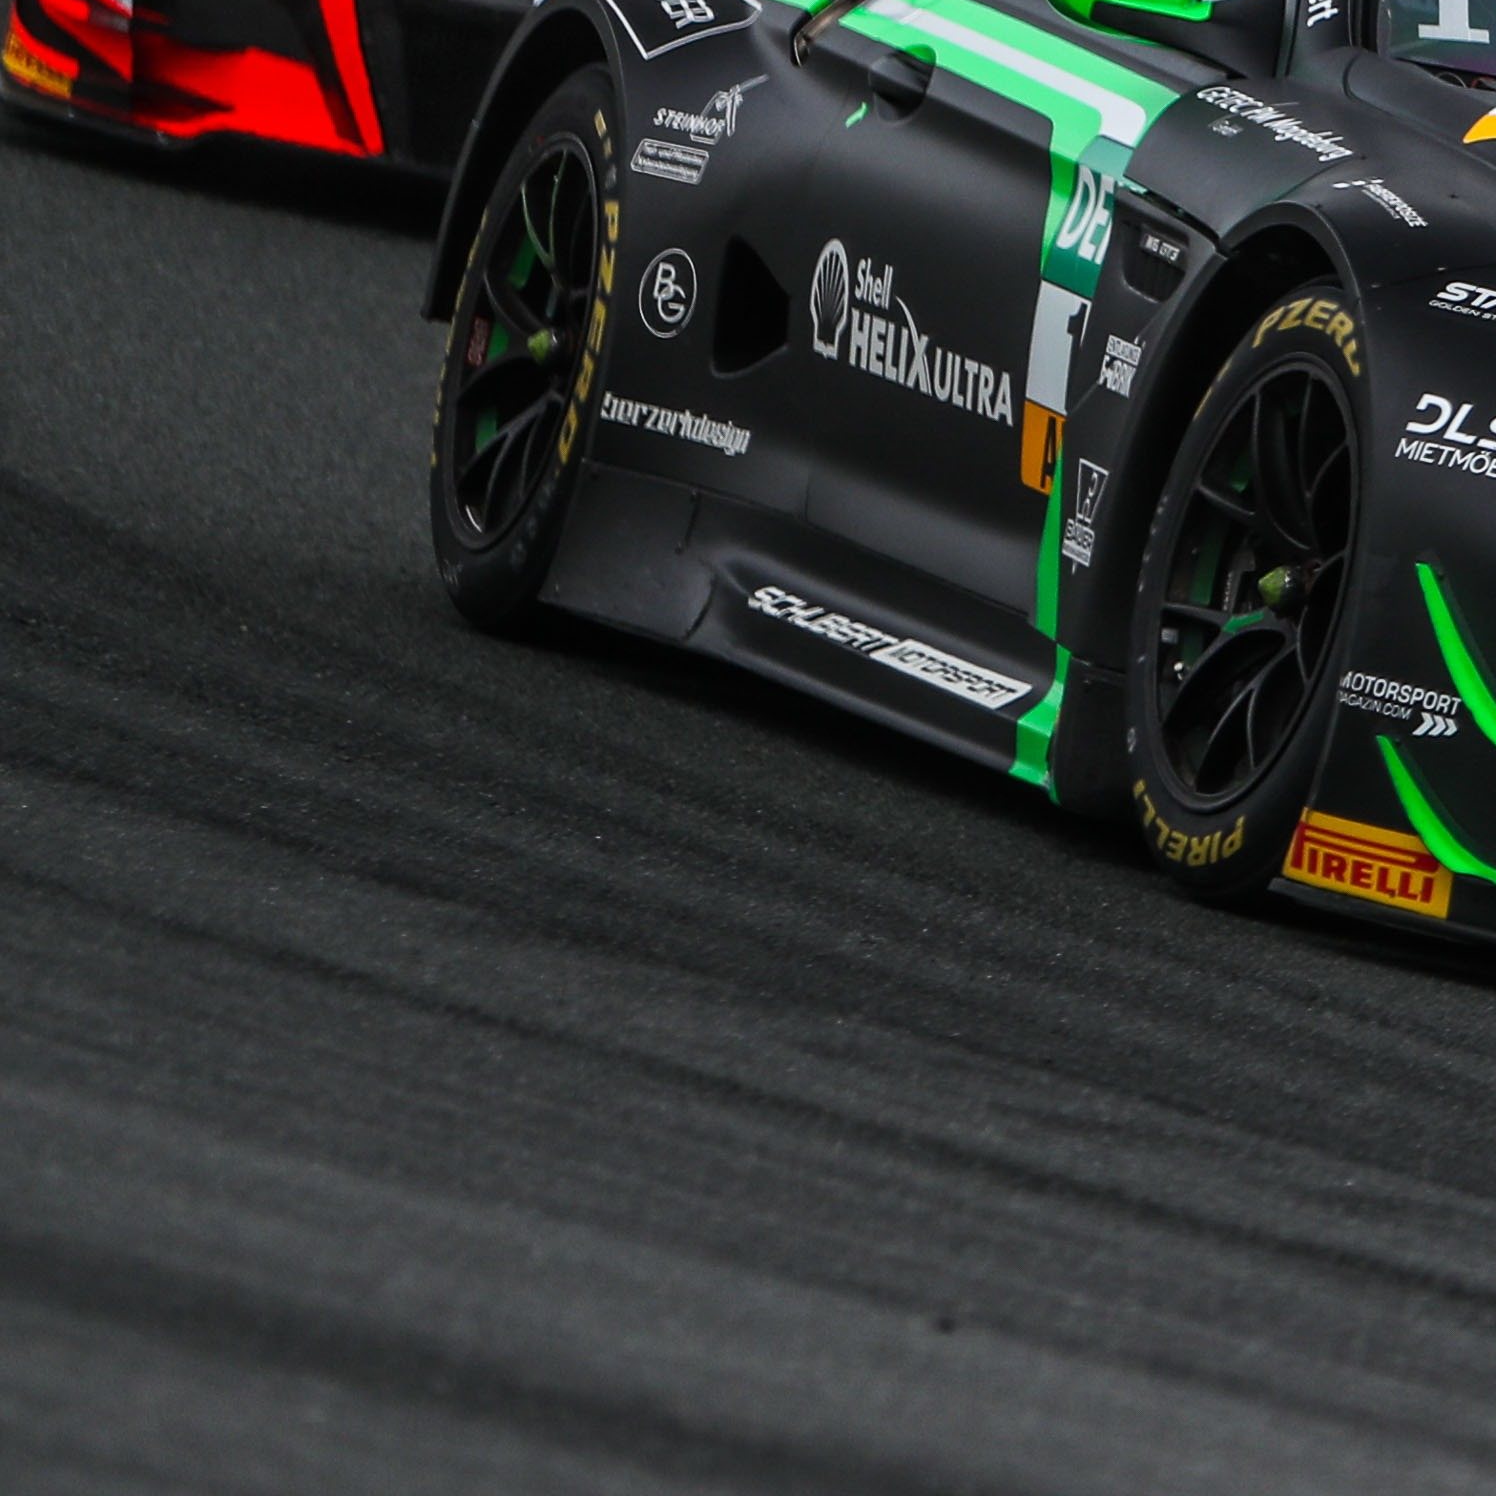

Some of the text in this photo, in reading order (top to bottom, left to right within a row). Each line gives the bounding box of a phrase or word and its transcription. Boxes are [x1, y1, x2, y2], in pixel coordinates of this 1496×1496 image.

[855, 257, 894, 310] Shell
[1428, 299, 1480, 317] GOLDEN
[849, 295, 1014, 427] HELIX ULTRA
[748, 585, 899, 656] SCHUBERT
[1289, 820, 1441, 904] PIRELLI
